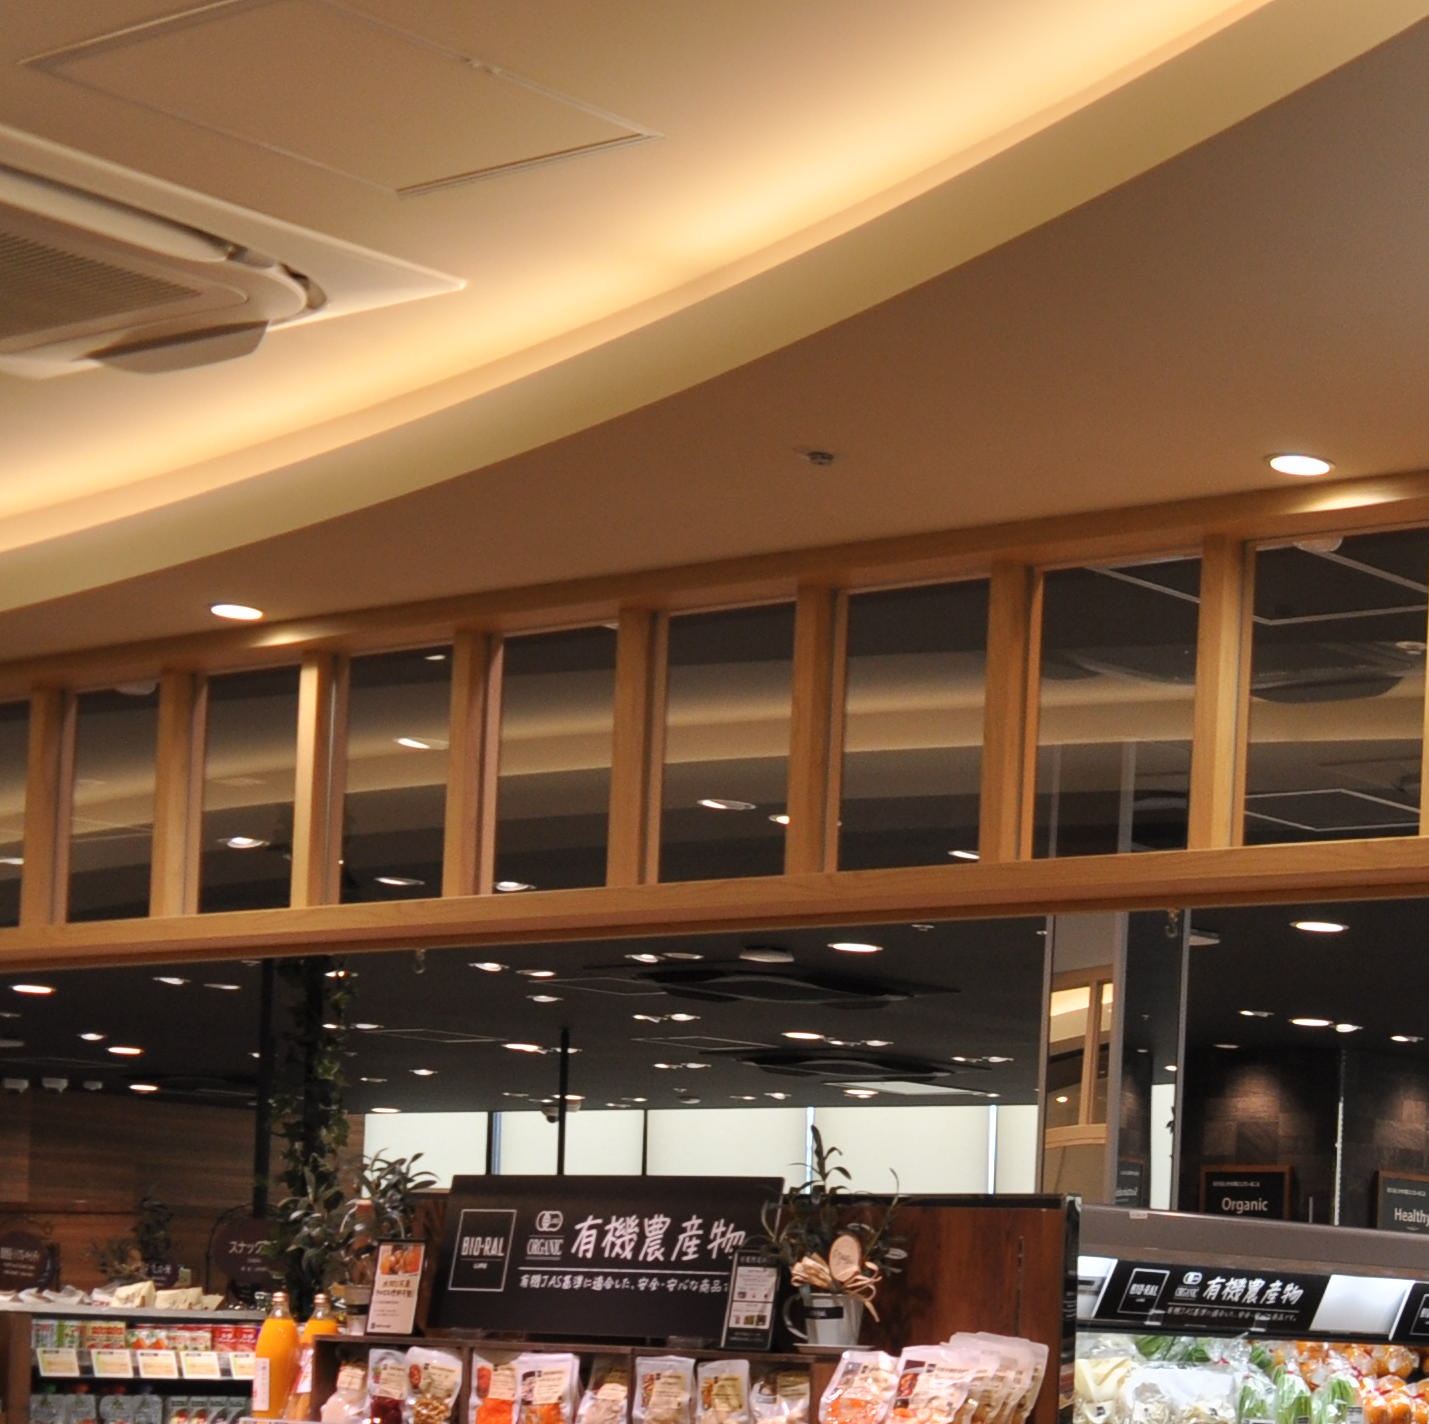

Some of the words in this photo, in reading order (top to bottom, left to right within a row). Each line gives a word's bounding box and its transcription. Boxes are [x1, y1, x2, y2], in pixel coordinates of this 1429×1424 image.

[1221, 1197, 1269, 1214] Organic
[461, 1236, 505, 1257] BIO-RAL
[527, 1238, 563, 1257] ORGANIC
[571, 1214, 746, 1262] 有機農産物
